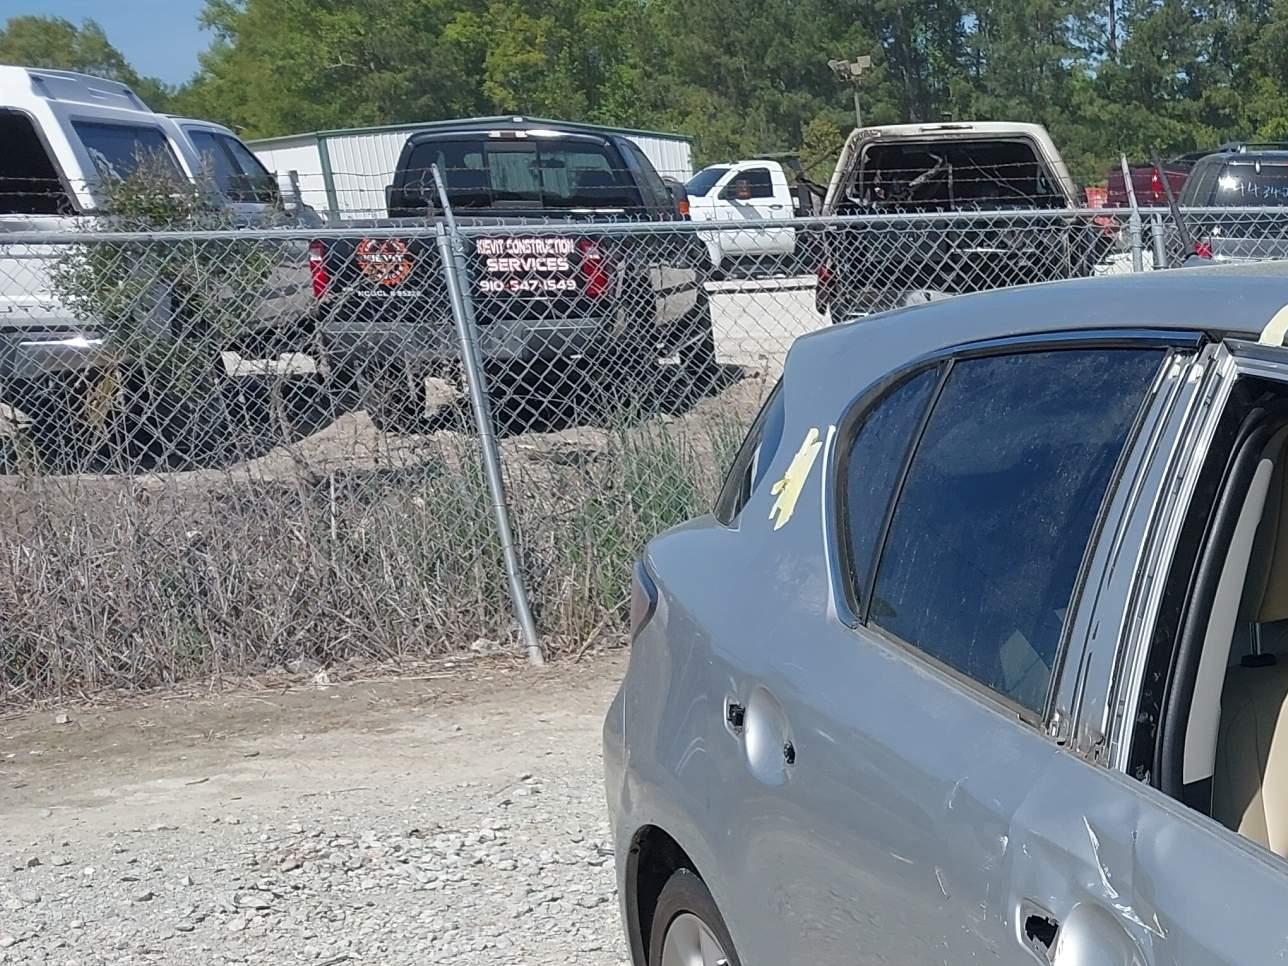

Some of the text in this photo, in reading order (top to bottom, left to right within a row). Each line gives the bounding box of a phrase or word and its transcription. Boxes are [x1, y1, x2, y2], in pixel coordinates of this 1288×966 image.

[476, 238, 575, 255] KIEVIT CONSTRUCTION
[486, 257, 569, 272] SERVICES
